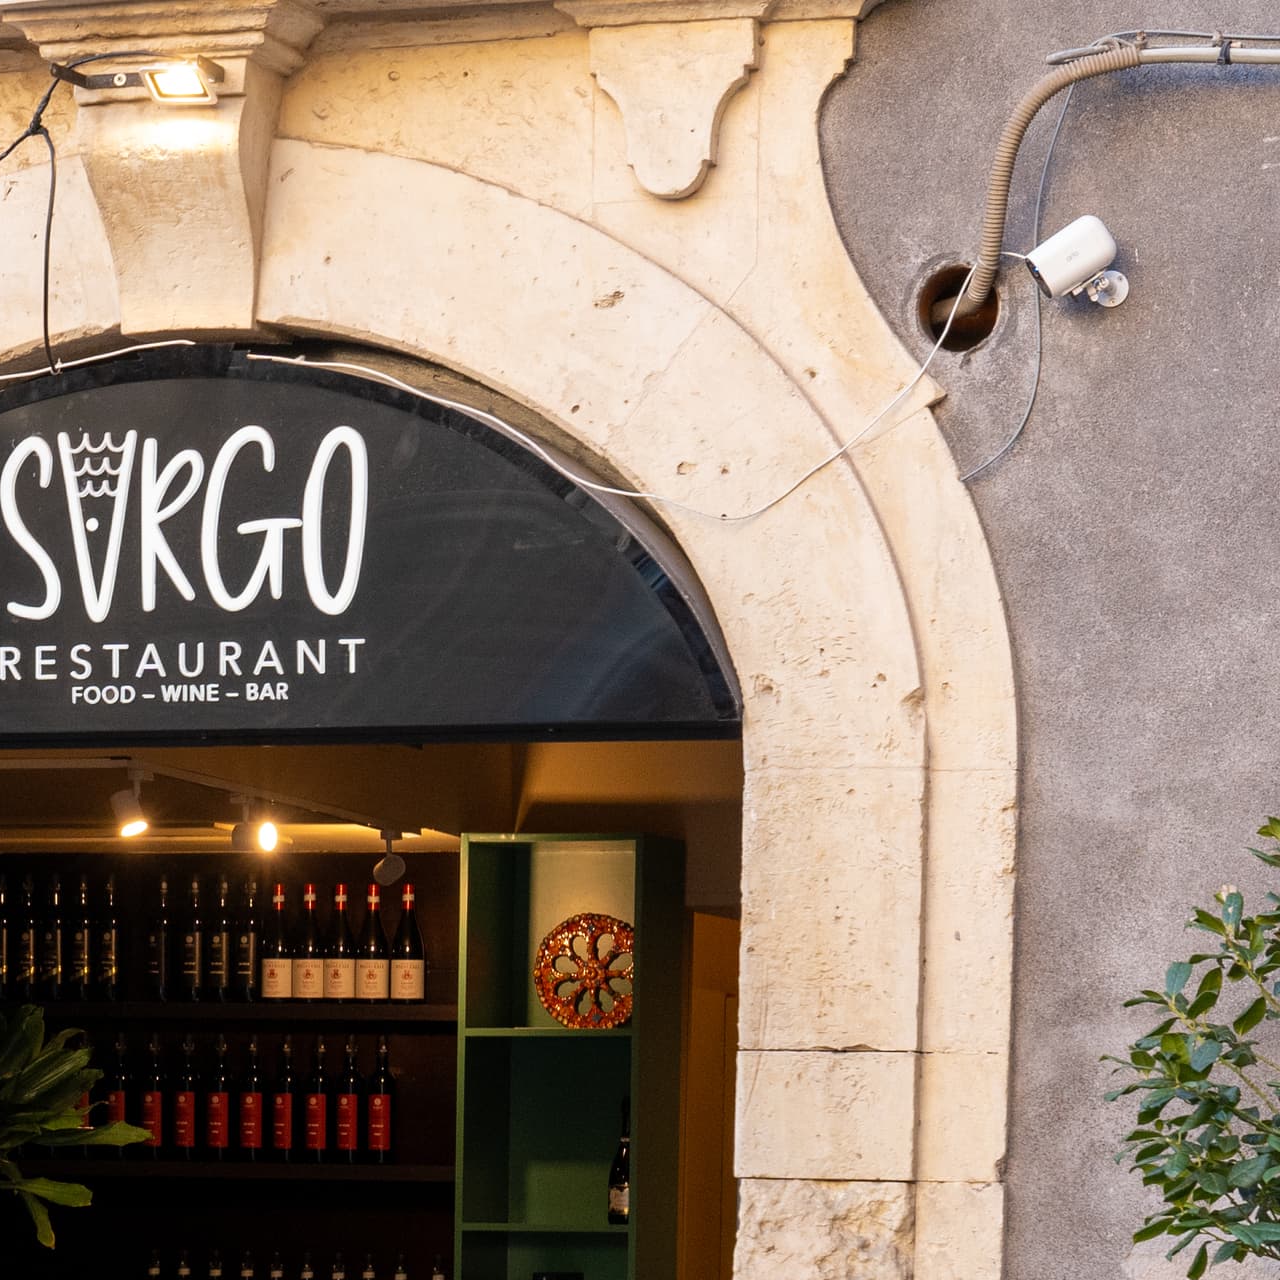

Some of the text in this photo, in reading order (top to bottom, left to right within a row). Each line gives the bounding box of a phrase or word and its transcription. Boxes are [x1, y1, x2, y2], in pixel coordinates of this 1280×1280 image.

[71, 685, 136, 705] FOOD
[160, 683, 220, 703] WINE
[245, 682, 289, 701] BAR
